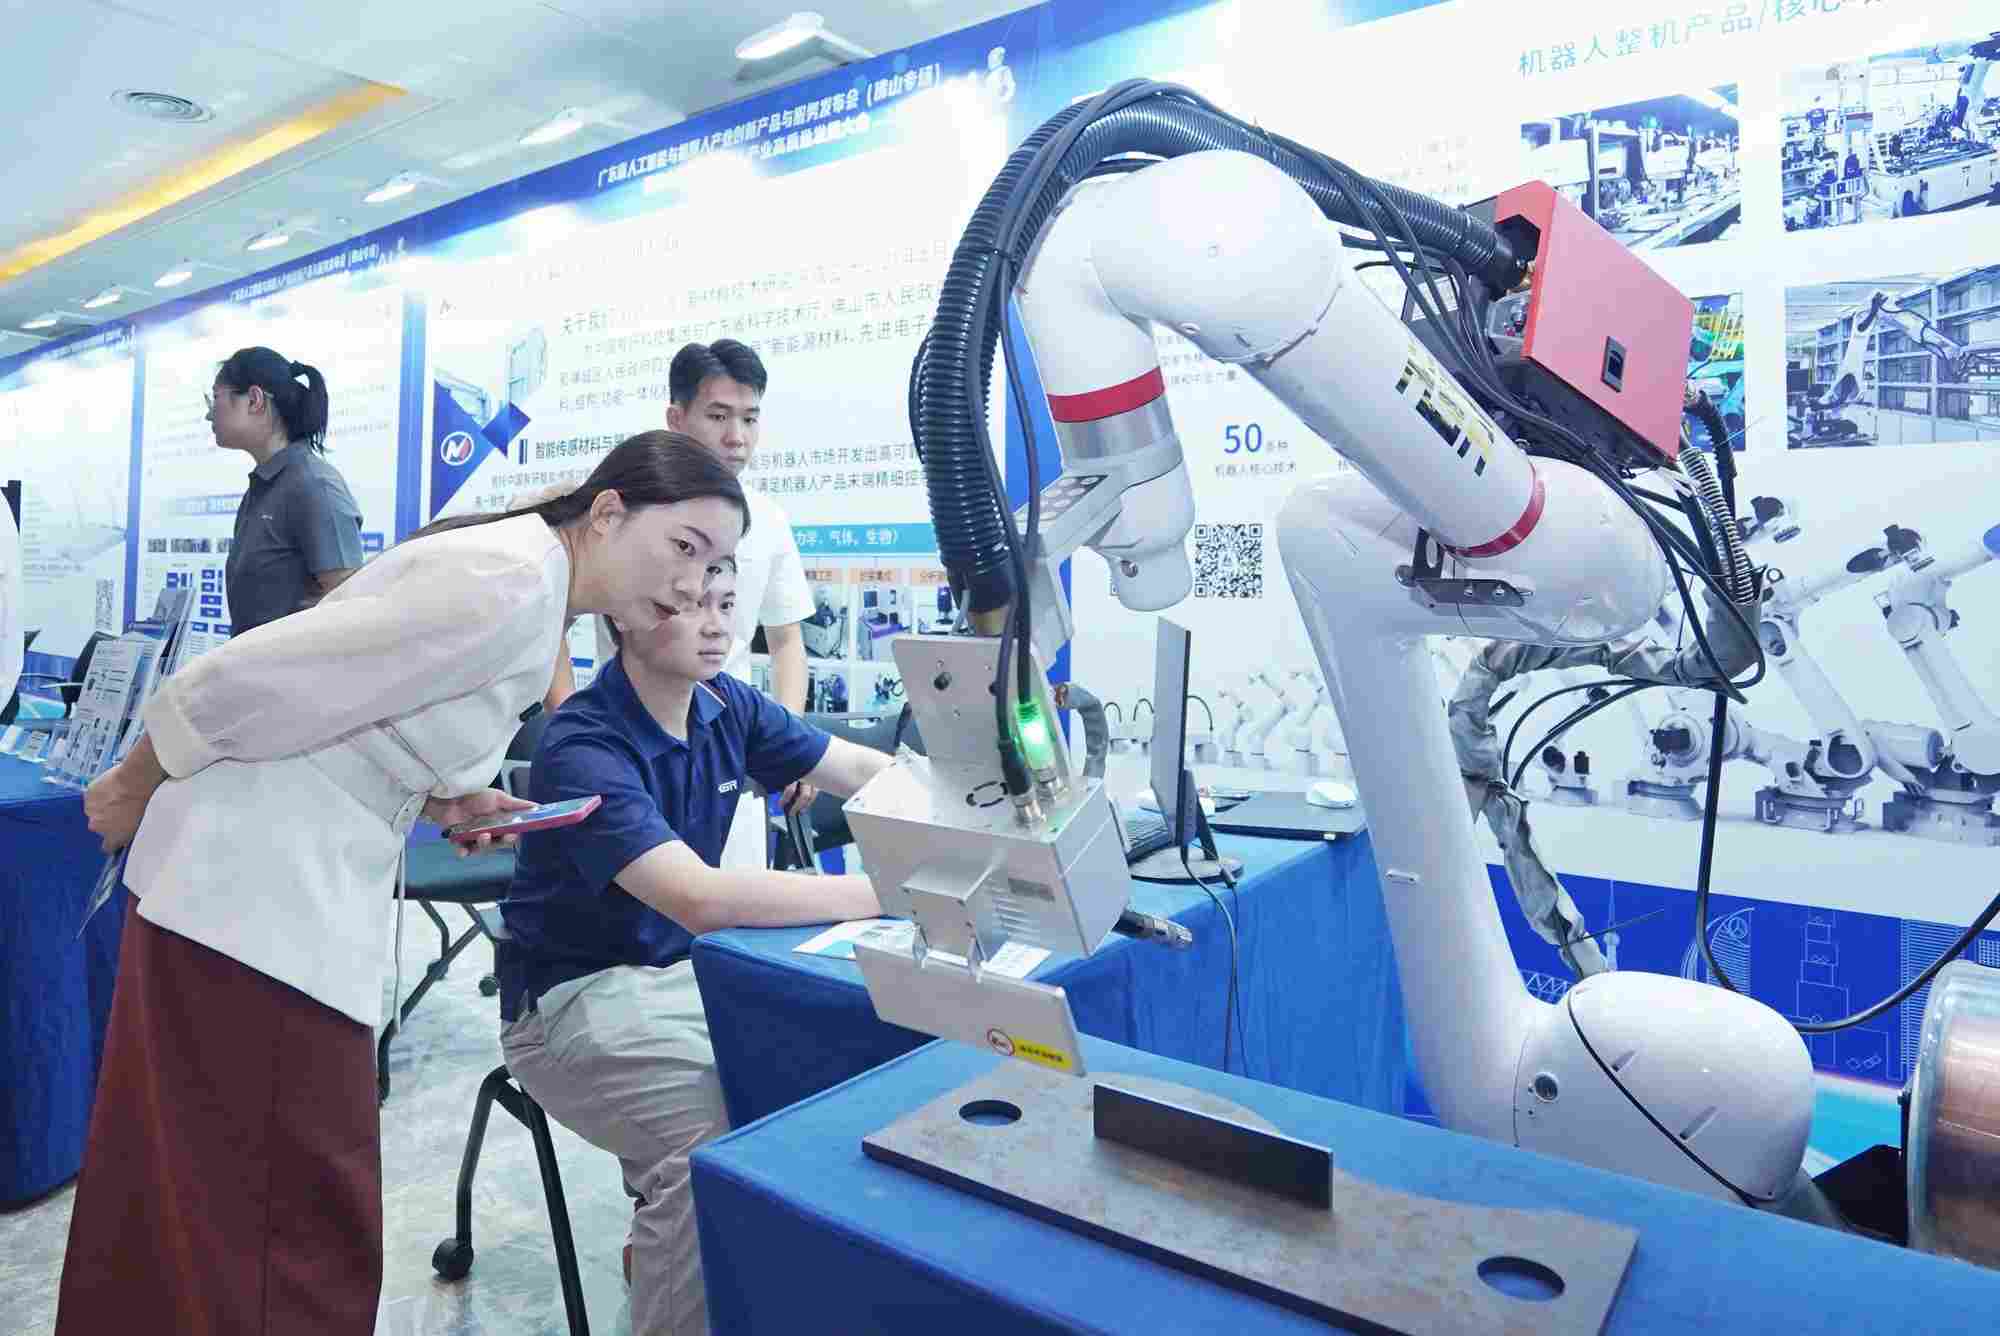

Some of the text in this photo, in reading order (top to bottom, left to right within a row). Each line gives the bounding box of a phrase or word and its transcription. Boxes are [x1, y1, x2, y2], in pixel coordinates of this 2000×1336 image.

[1518, 0, 1881, 77] 机器人整机产品/核心
[1223, 423, 1262, 454] 50
